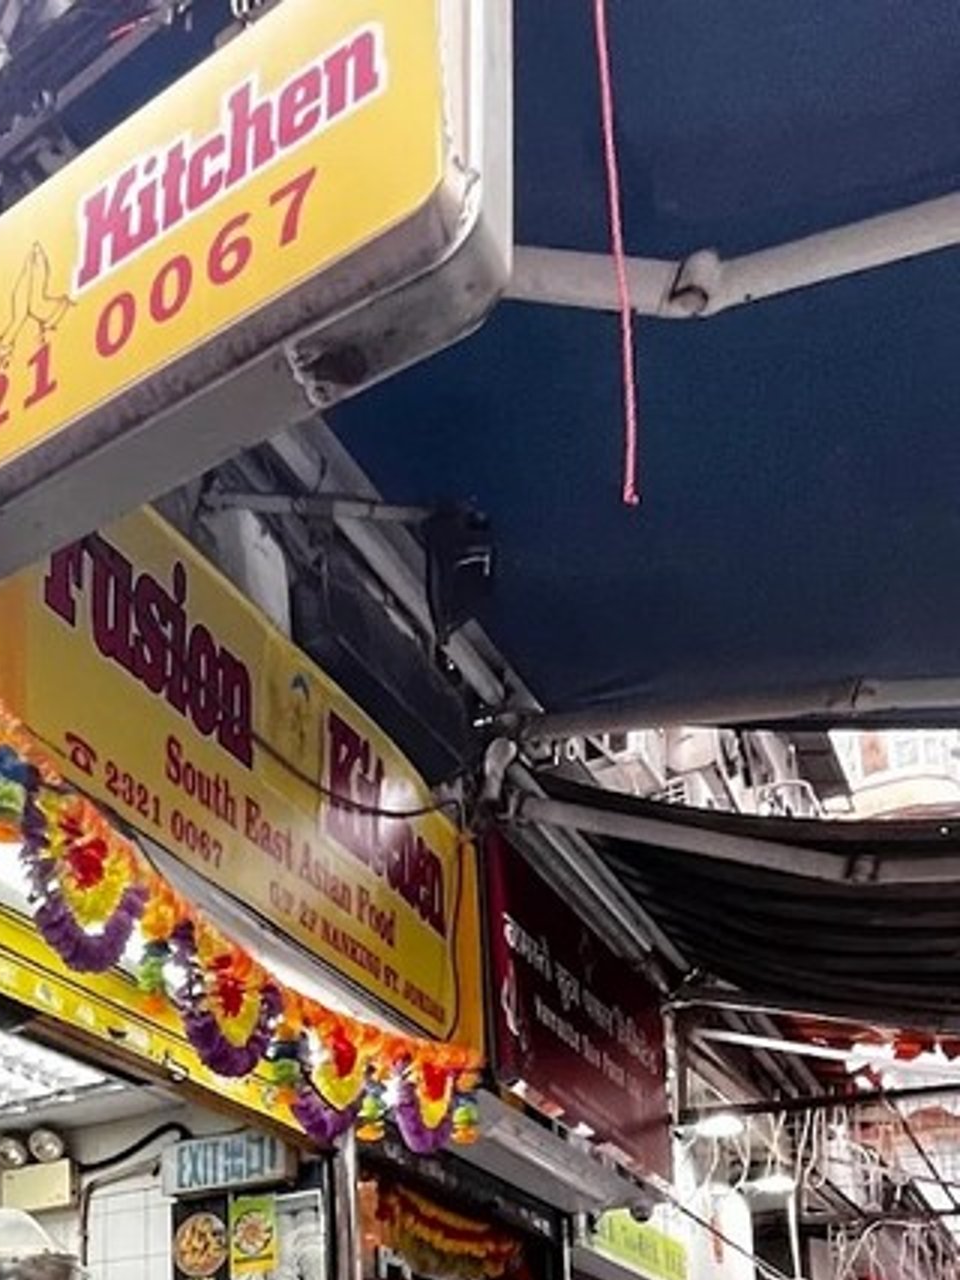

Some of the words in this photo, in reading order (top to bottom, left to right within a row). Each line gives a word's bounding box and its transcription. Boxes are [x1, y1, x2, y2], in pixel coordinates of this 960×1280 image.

[77, 31, 381, 288] Kitchen
[94, 167, 318, 358] 0067
[44, 531, 253, 769] Fusion
[105, 760, 161, 826] 2321
[171, 810, 222, 868] 0067
[165, 734, 237, 829] South
[245, 796, 292, 871] East
[300, 842, 351, 914] Asian
[357, 885, 396, 948] Food
[176, 1140, 220, 1188] EXIT
